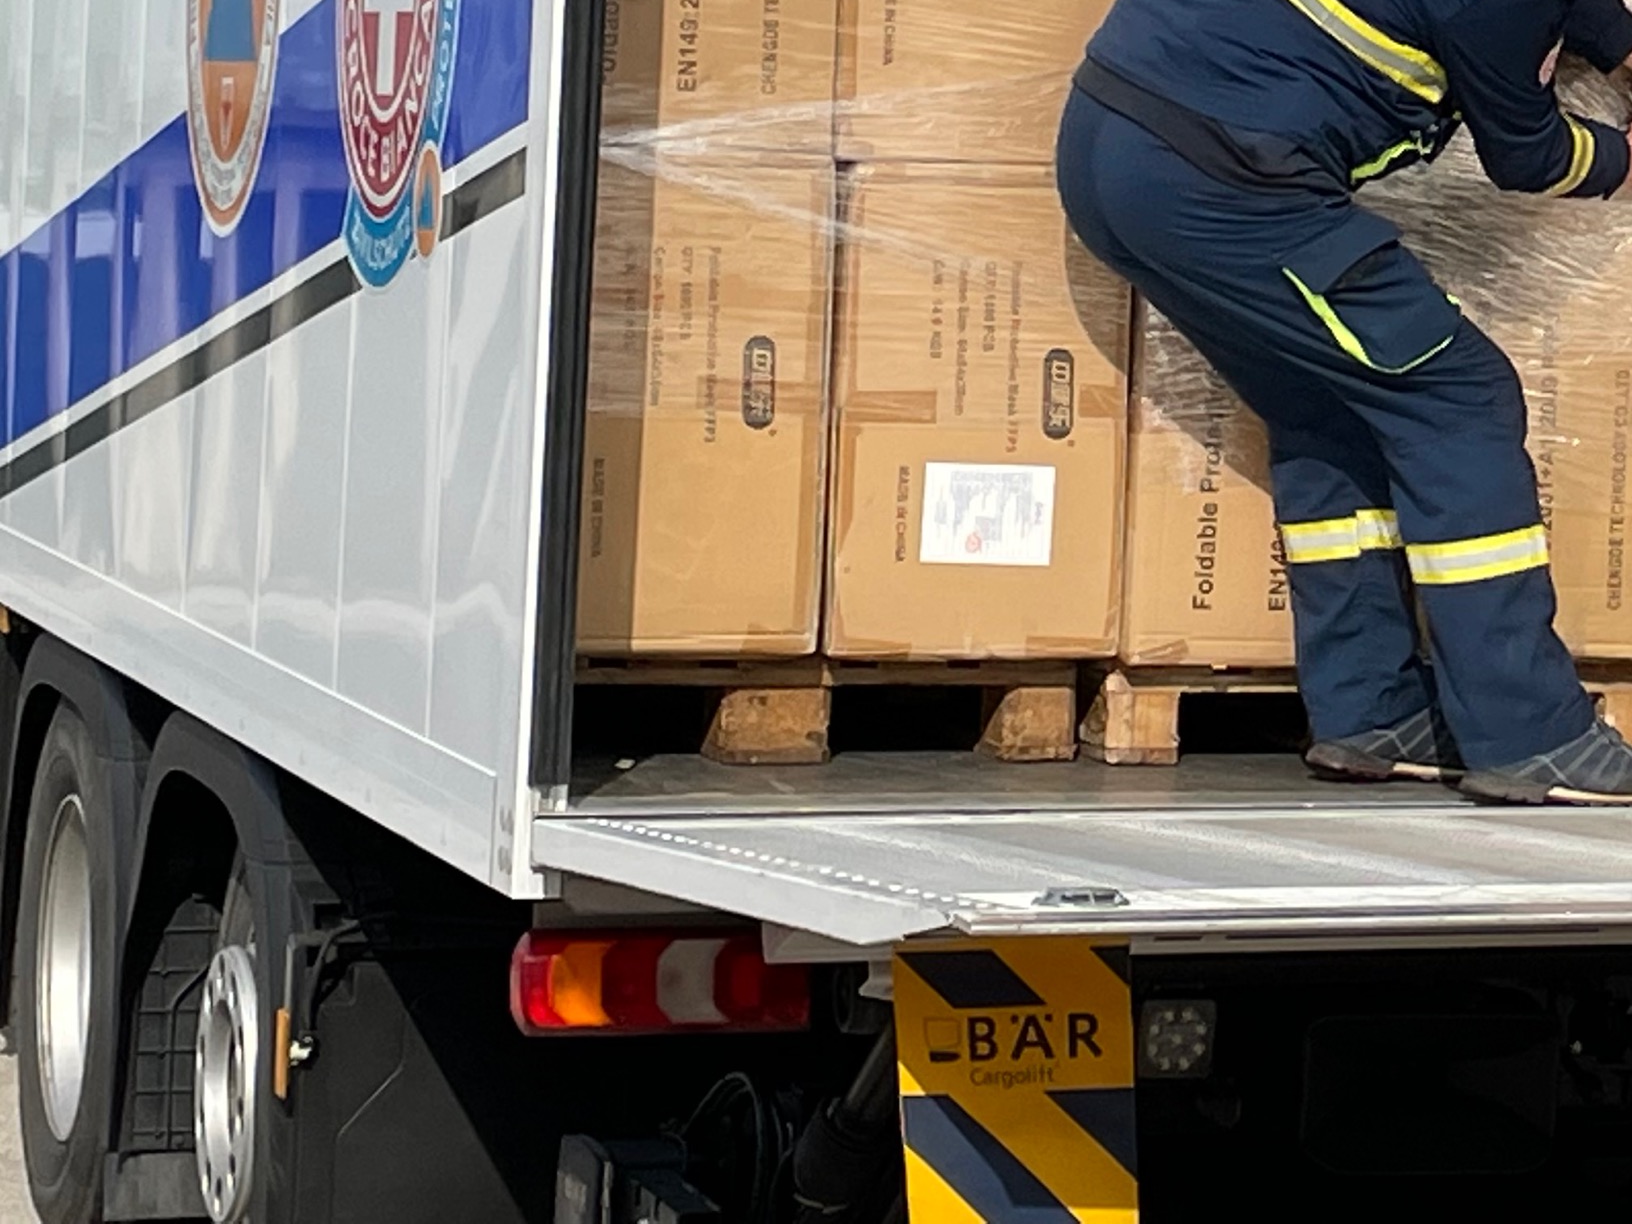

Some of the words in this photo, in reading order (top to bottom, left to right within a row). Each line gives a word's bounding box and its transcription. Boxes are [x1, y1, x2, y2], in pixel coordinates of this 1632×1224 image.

[1608, 431, 1628, 534] TECHNOLOGY
[1191, 502, 1219, 611] Foldable
[1605, 537, 1625, 611] CHENGDE
[966, 1011, 1104, 1063] BÄR
[969, 1065, 1055, 1090] Cargolift
